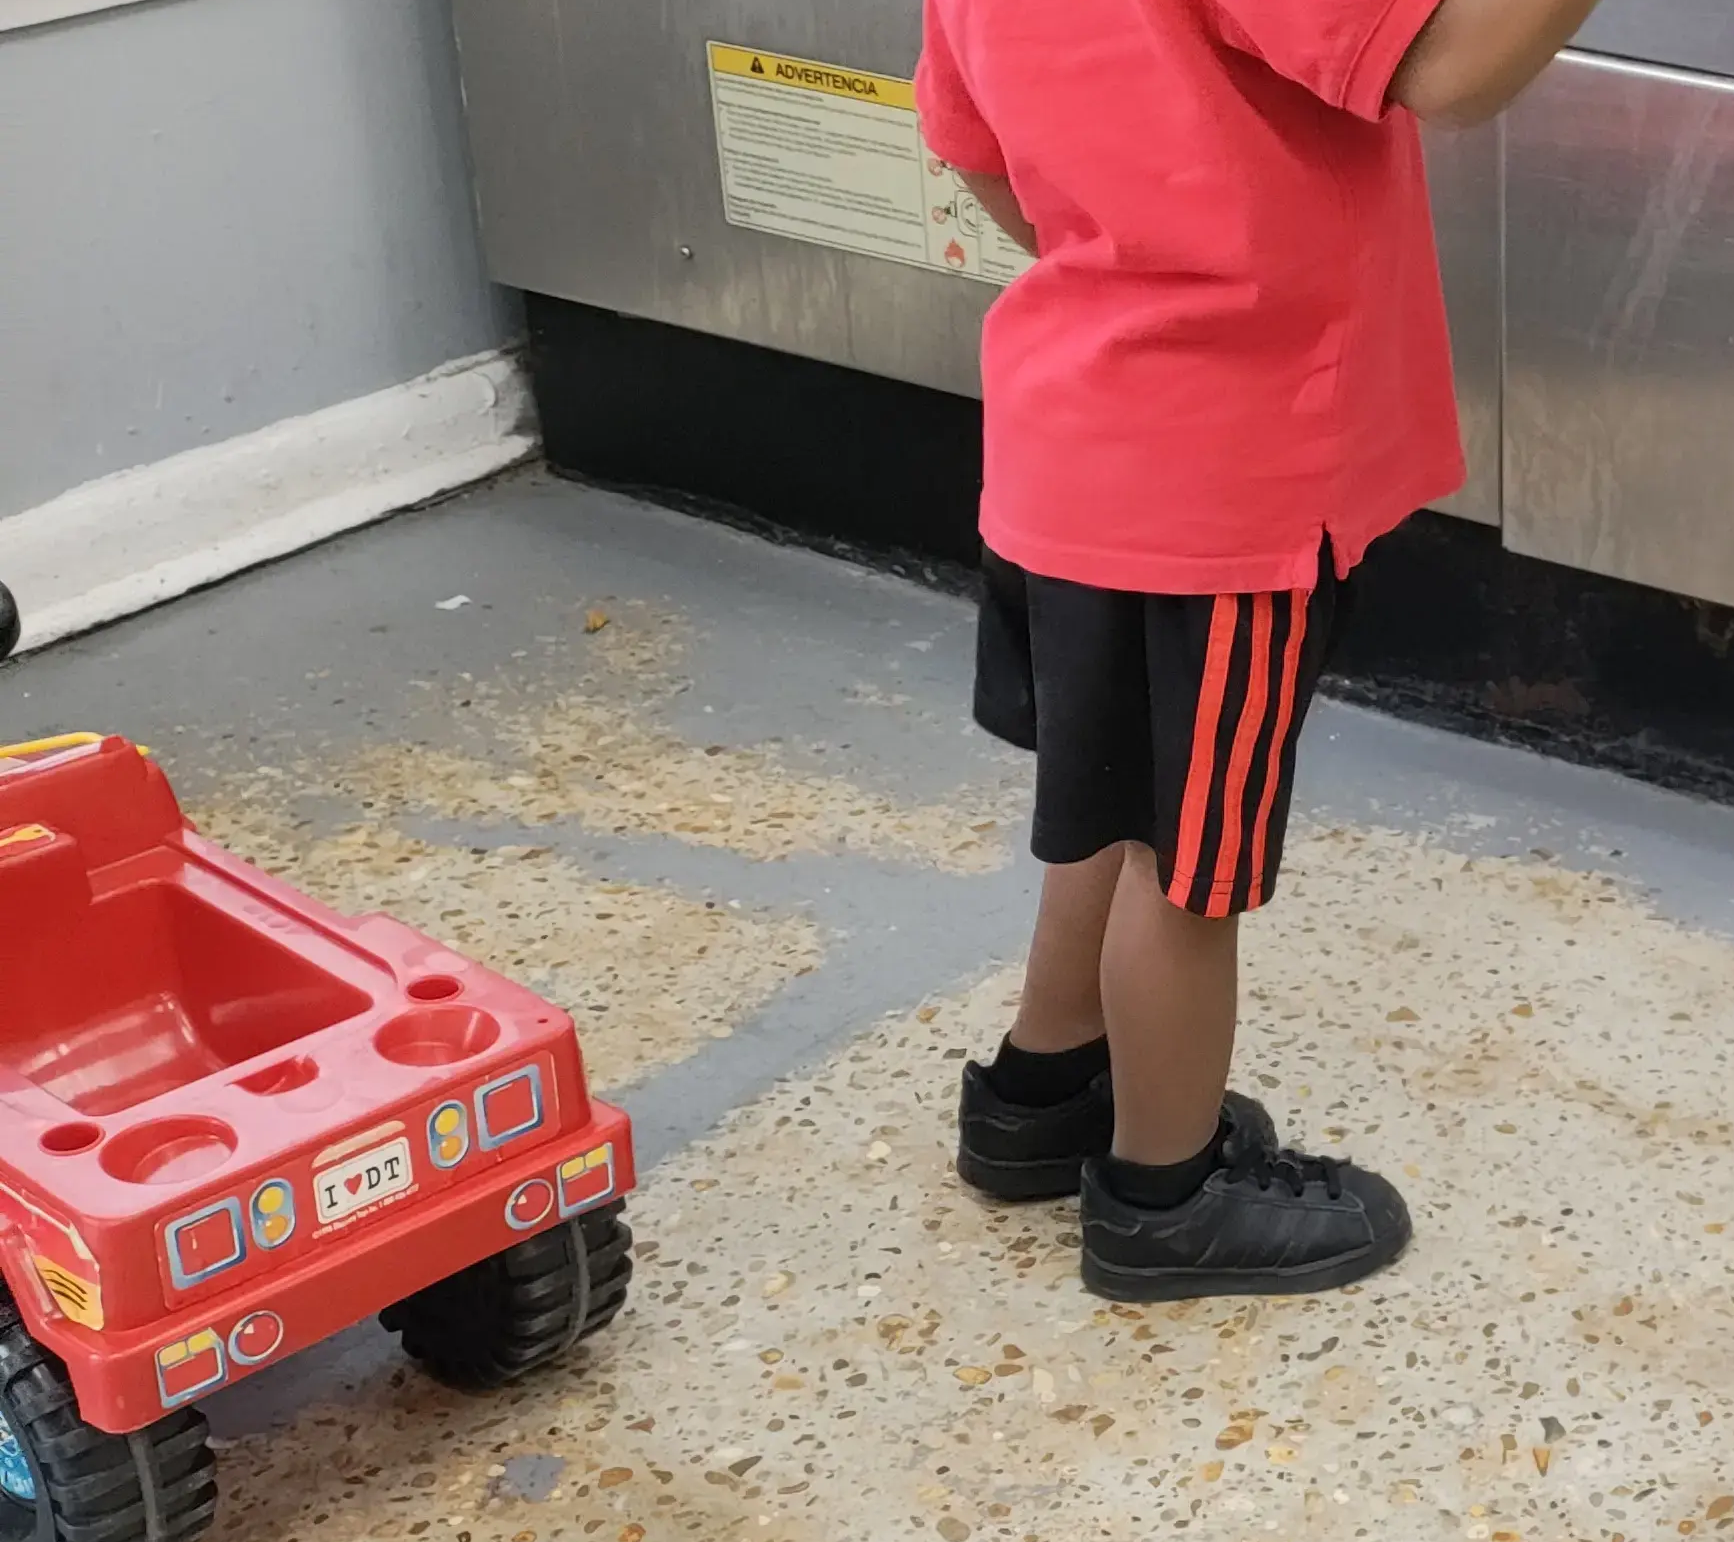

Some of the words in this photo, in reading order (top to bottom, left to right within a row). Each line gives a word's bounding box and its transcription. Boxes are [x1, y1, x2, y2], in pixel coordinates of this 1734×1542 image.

[775, 62, 879, 97] ADVERTENCIA
[324, 1184, 338, 1209] I
[365, 1156, 400, 1190] DT
